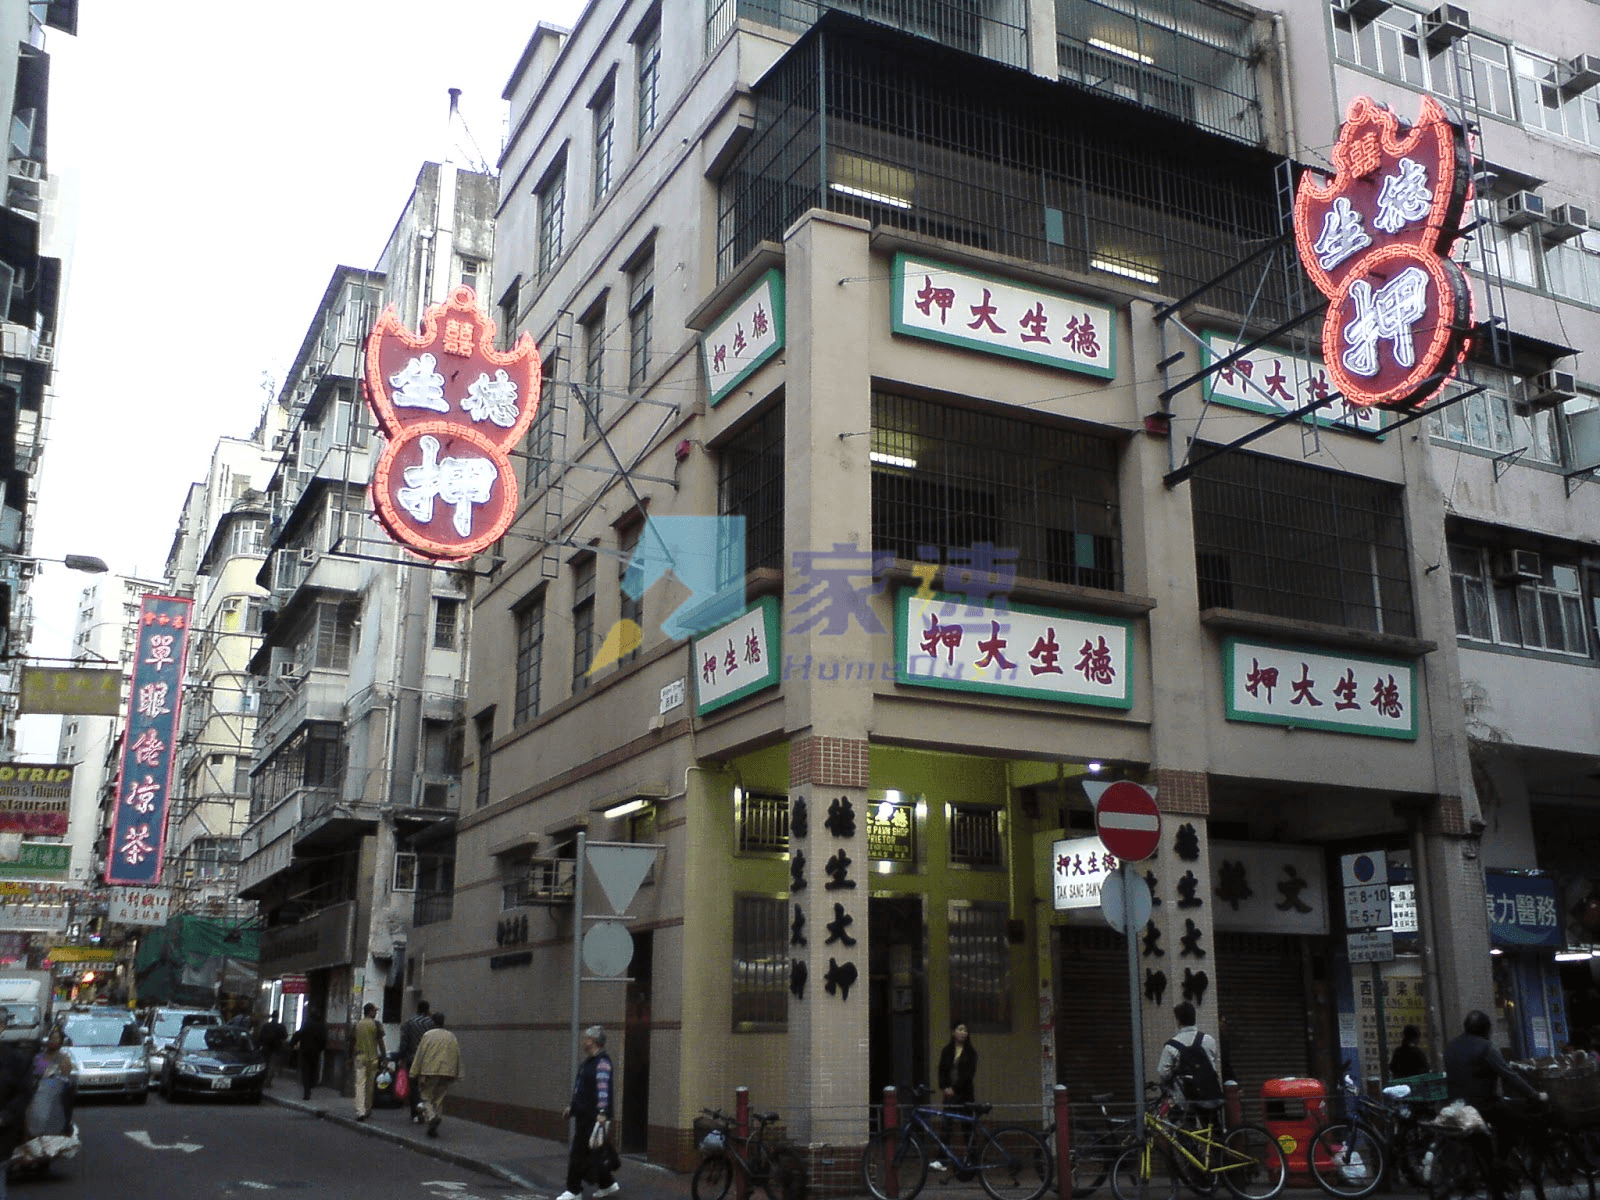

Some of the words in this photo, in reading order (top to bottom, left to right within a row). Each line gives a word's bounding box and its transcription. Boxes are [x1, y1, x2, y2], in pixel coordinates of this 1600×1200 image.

[1343, 267, 1429, 376] 押
[397, 435, 498, 537] 押
[1143, 848, 1168, 1007] 生大押
[1360, 889, 1387, 903] 8-10
[1362, 909, 1382, 923] 5-7
